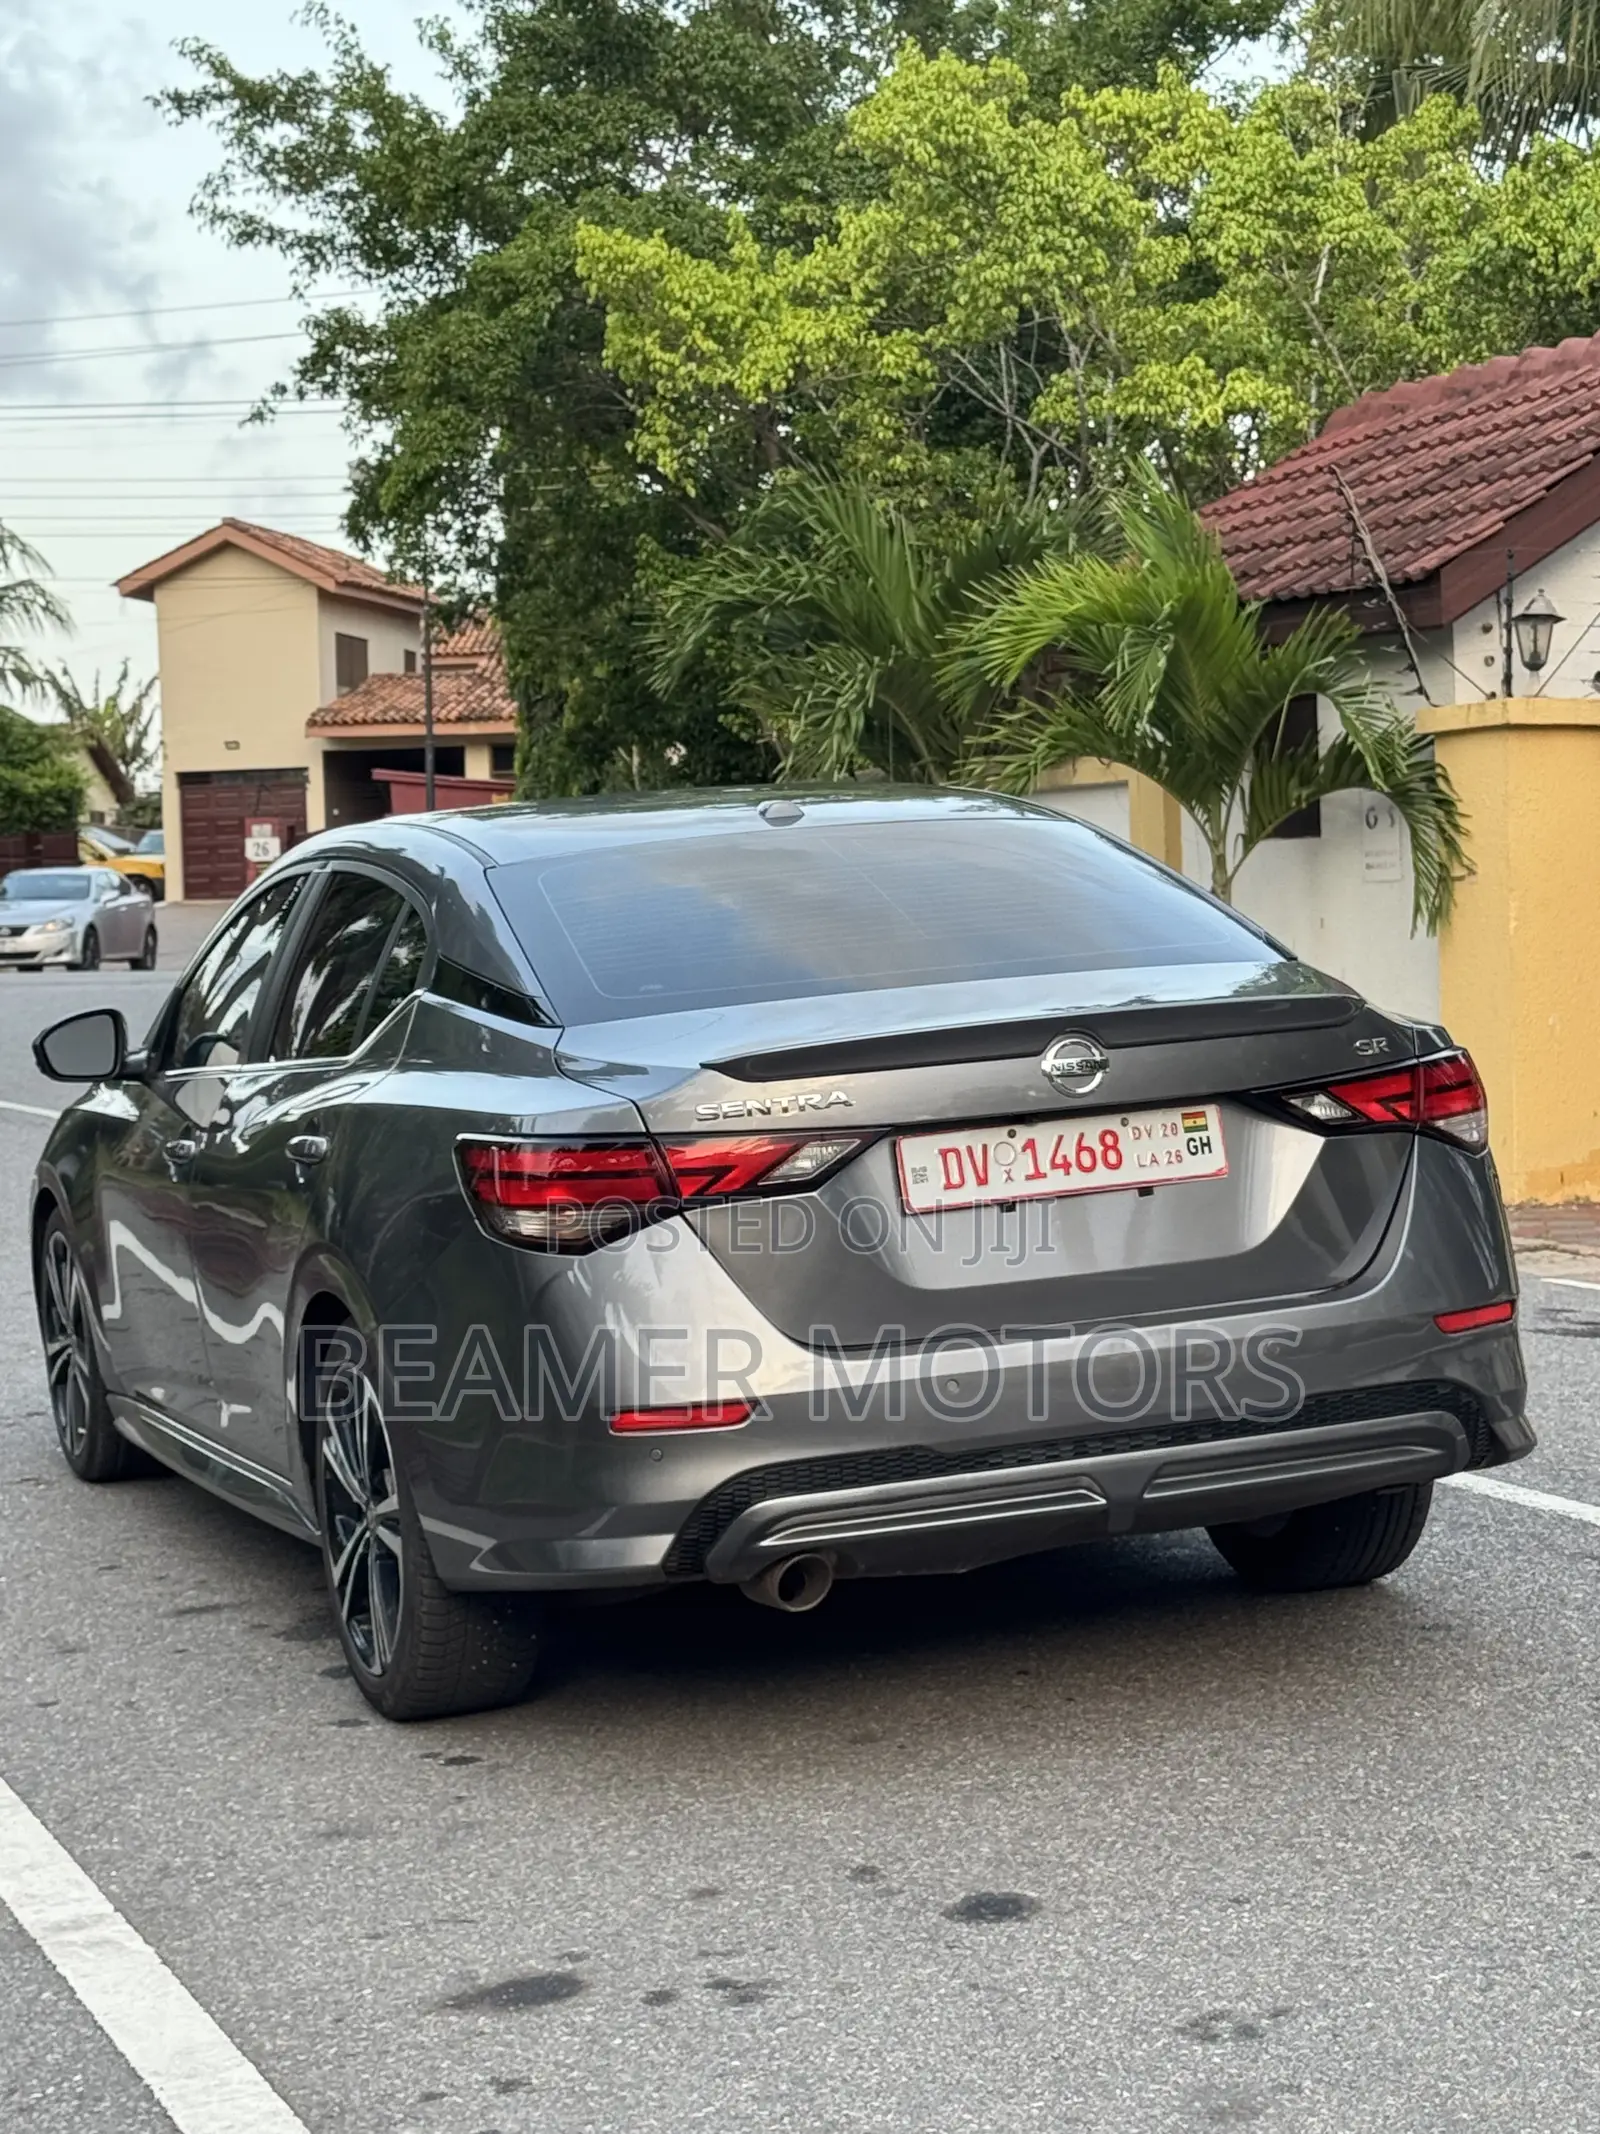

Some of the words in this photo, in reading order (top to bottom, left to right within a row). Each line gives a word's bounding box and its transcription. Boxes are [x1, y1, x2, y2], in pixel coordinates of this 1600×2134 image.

[253, 841, 270, 857] 26
[1353, 1037, 1390, 1055] SR
[1050, 1060, 1101, 1072] NISSAN
[695, 1090, 856, 1122] SENTRA
[1131, 1125, 1153, 1140] DV
[1186, 1136, 1213, 1156] GH
[938, 1143, 988, 1190] DV
[1021, 1129, 1122, 1180] 1468
[1136, 1152, 1160, 1168] LA
[1165, 1149, 1183, 1164] 26
